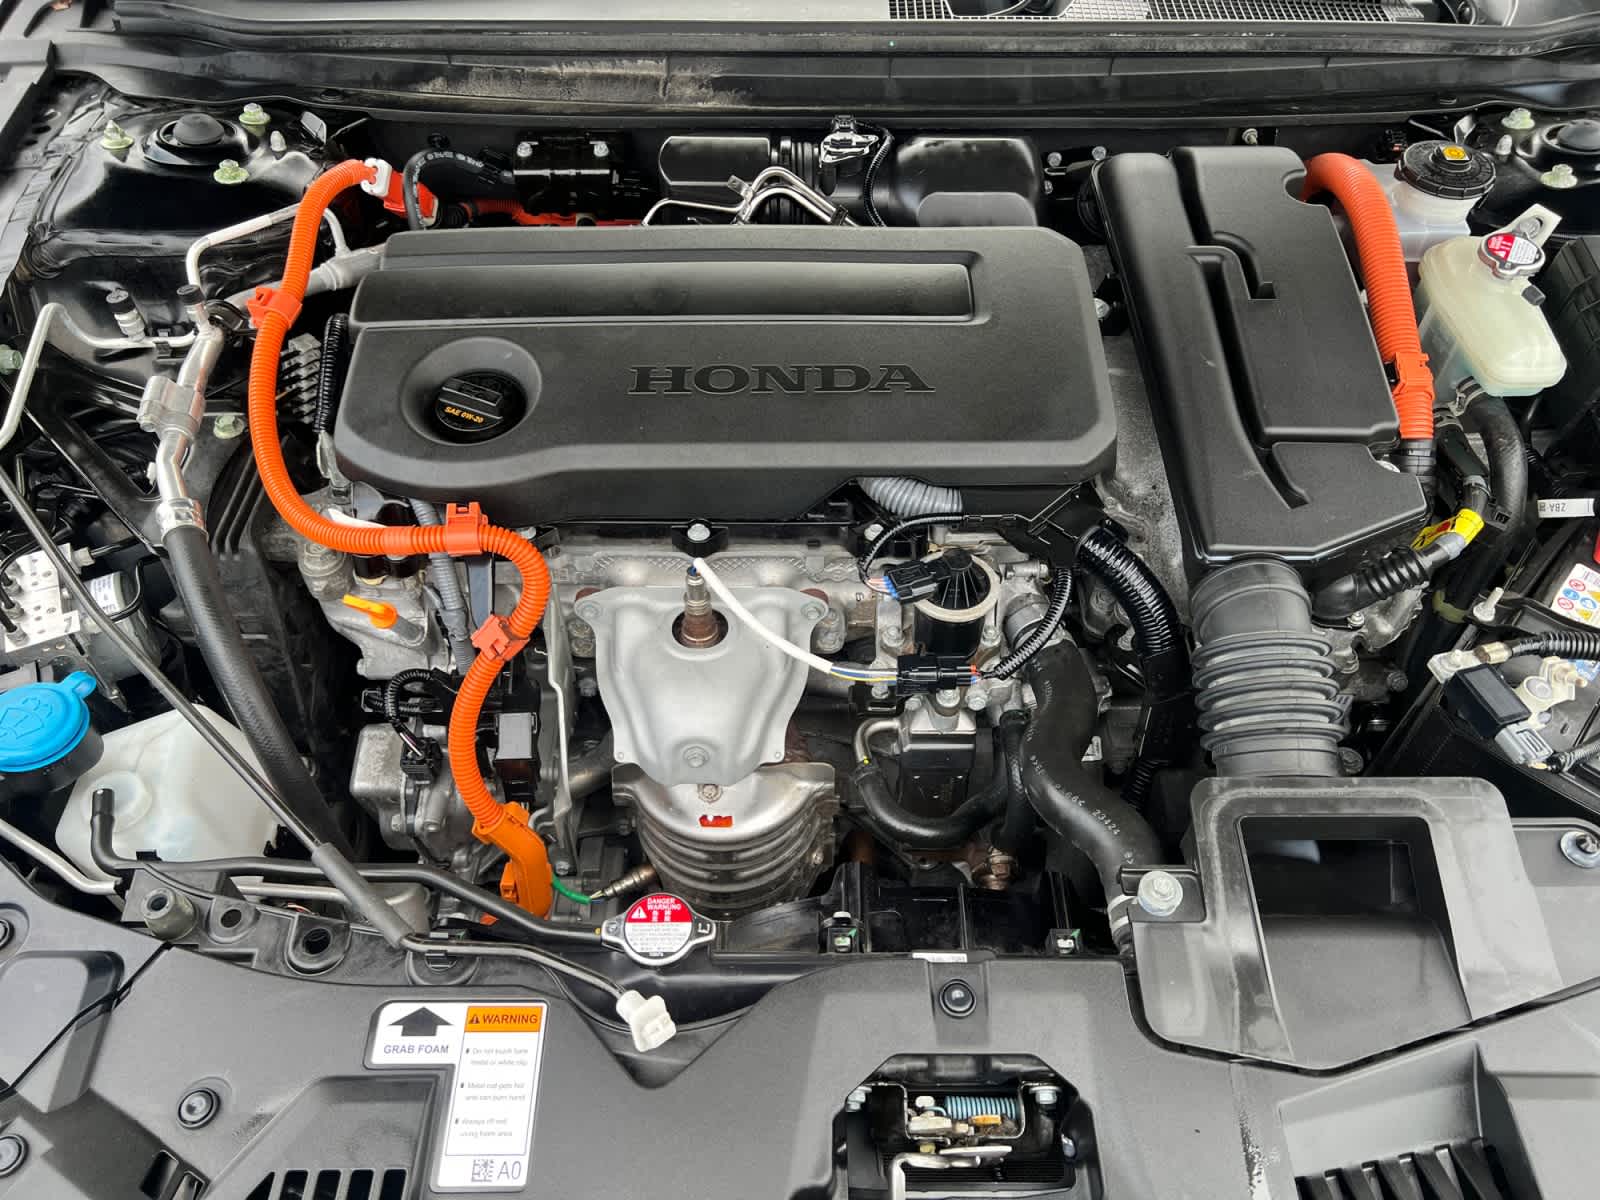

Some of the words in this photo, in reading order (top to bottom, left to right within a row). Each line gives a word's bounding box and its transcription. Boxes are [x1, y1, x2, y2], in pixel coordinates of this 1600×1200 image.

[628, 364, 936, 394] HONDA
[444, 406, 462, 417] SAE
[461, 412, 484, 423] 0W-20
[482, 1014, 538, 1025] WARNING
[383, 1044, 415, 1055] GRAB
[417, 1044, 449, 1055] FOAM
[496, 1160, 522, 1180] A0
